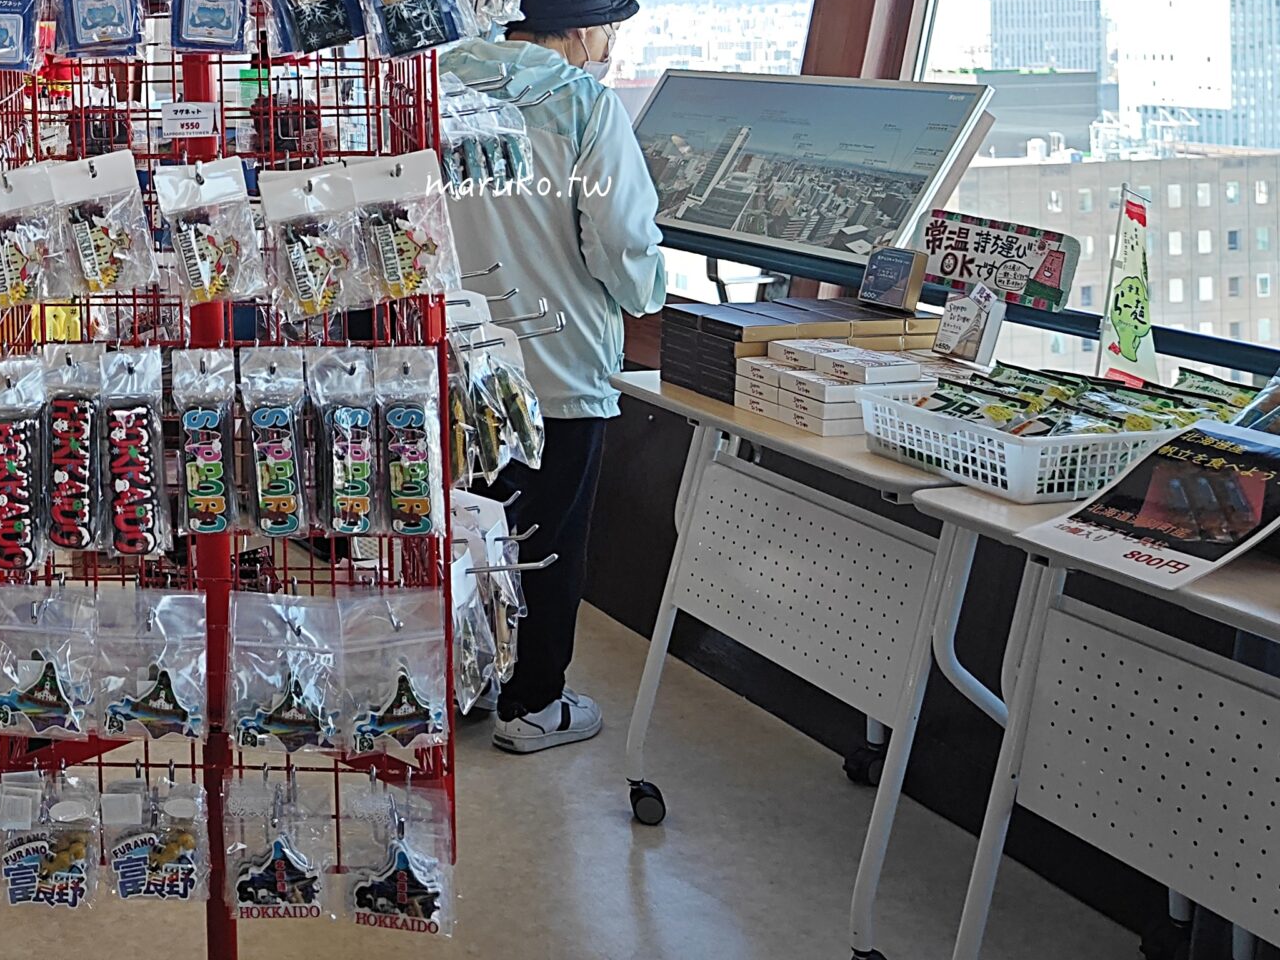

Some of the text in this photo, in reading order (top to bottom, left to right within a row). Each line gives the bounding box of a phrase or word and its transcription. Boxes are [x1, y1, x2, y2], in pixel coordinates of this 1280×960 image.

[172, 108, 202, 116] マグネット
[180, 121, 200, 130] ¥550
[376, 225, 401, 283] HOKKAIDO
[924, 219, 1032, 259] 常温 持ち運び
[178, 232, 204, 288] HOKKAIDO
[976, 286, 993, 303] 見本
[1180, 432, 1249, 456] 北海道産
[50, 399, 92, 548] HOKKAIDO
[182, 406, 228, 533] SAPPORO
[252, 407, 299, 535] SAPPORO
[386, 407, 433, 535] SAPPORO
[1122, 550, 1191, 575] 800円
[3, 843, 49, 866] FURANO
[112, 836, 157, 859] FURANO
[3, 863, 88, 908] 富良野
[113, 855, 198, 900] 富良野
[239, 905, 321, 918] HOKKAIDO
[355, 911, 439, 935] HOKKAIDO
